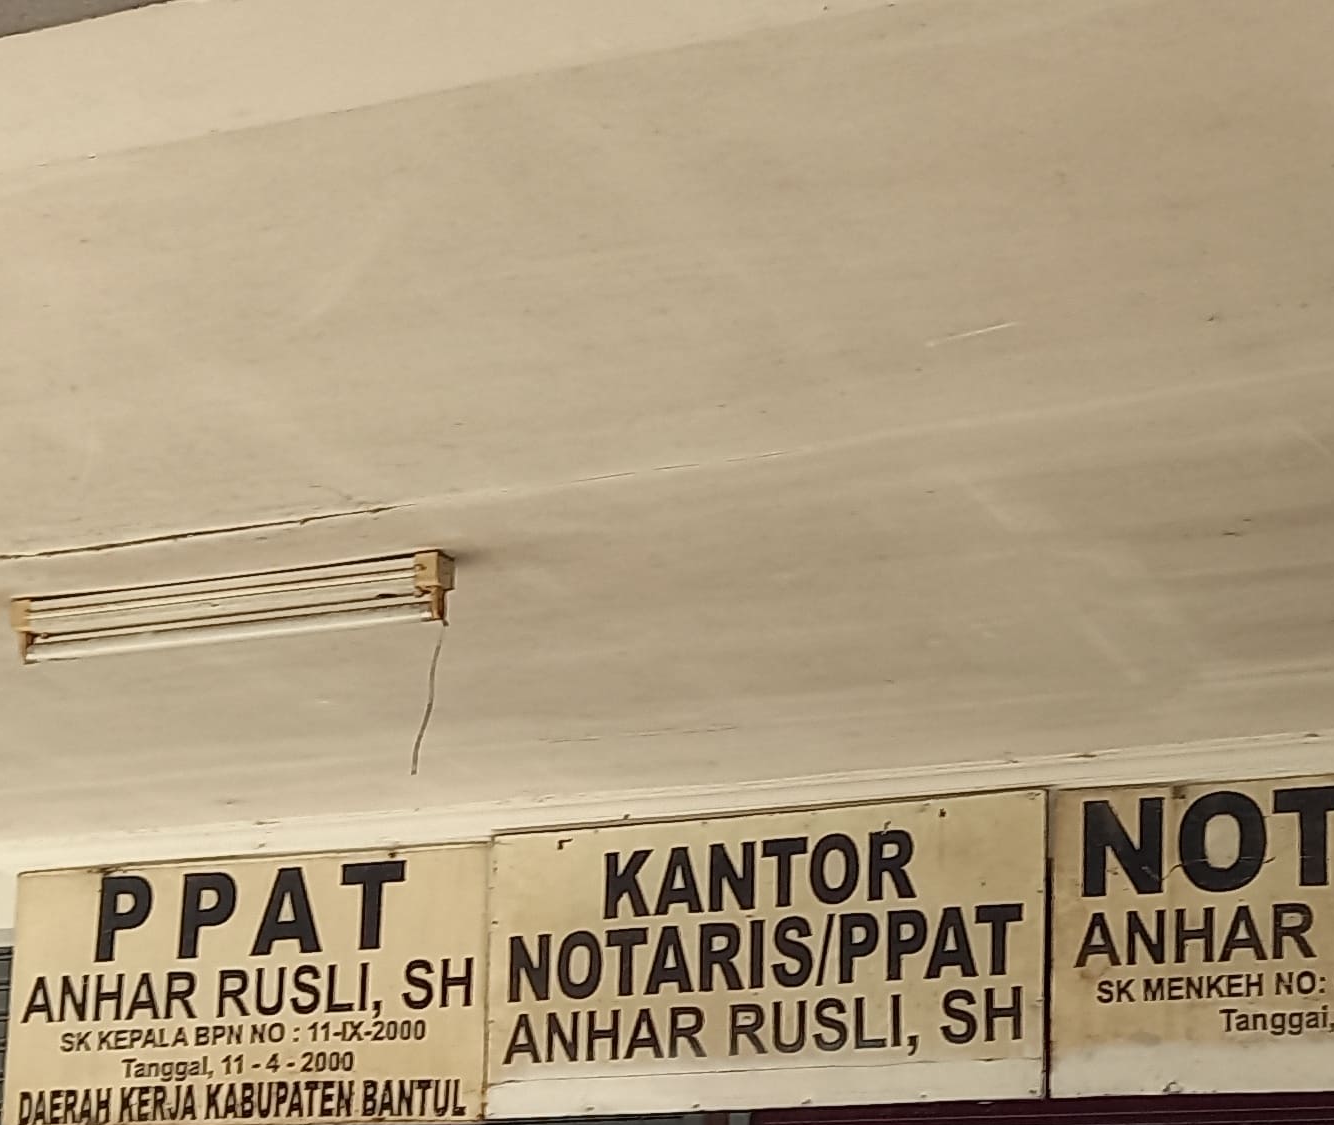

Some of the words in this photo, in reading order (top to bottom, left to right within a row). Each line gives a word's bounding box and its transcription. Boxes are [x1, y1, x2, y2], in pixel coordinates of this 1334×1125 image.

[603, 829, 917, 920] KANTOR
[508, 903, 1024, 1002] NOTARIS/PPAT
[1073, 902, 1314, 968] ANHAR
[20, 970, 197, 1024] ANHAR
[215, 962, 383, 1019] RUSLI,
[401, 957, 474, 1009] SH
[1097, 979, 1135, 1004] SK
[1143, 973, 1264, 1001] MENKEH
[1275, 970, 1327, 995] NO:
[60, 1031, 92, 1052] SK
[97, 1027, 189, 1051] KEPALA
[194, 1024, 243, 1046] BPN
[308, 1019, 426, 1042] 11-IX-2000
[503, 1006, 707, 1065] ANHAR
[729, 995, 920, 1056] RUSLI,
[940, 986, 1024, 1045] SH
[121, 1055, 214, 1082] Tanggal,
[221, 1054, 244, 1075] 11
[265, 1053, 280, 1073] 4
[300, 1051, 355, 1073] 2000
[18, 1087, 113, 1125] DAERAH
[119, 1084, 197, 1122] KERJA
[204, 1080, 355, 1119] KABUPATEN
[361, 1079, 467, 1117] BANTUL
